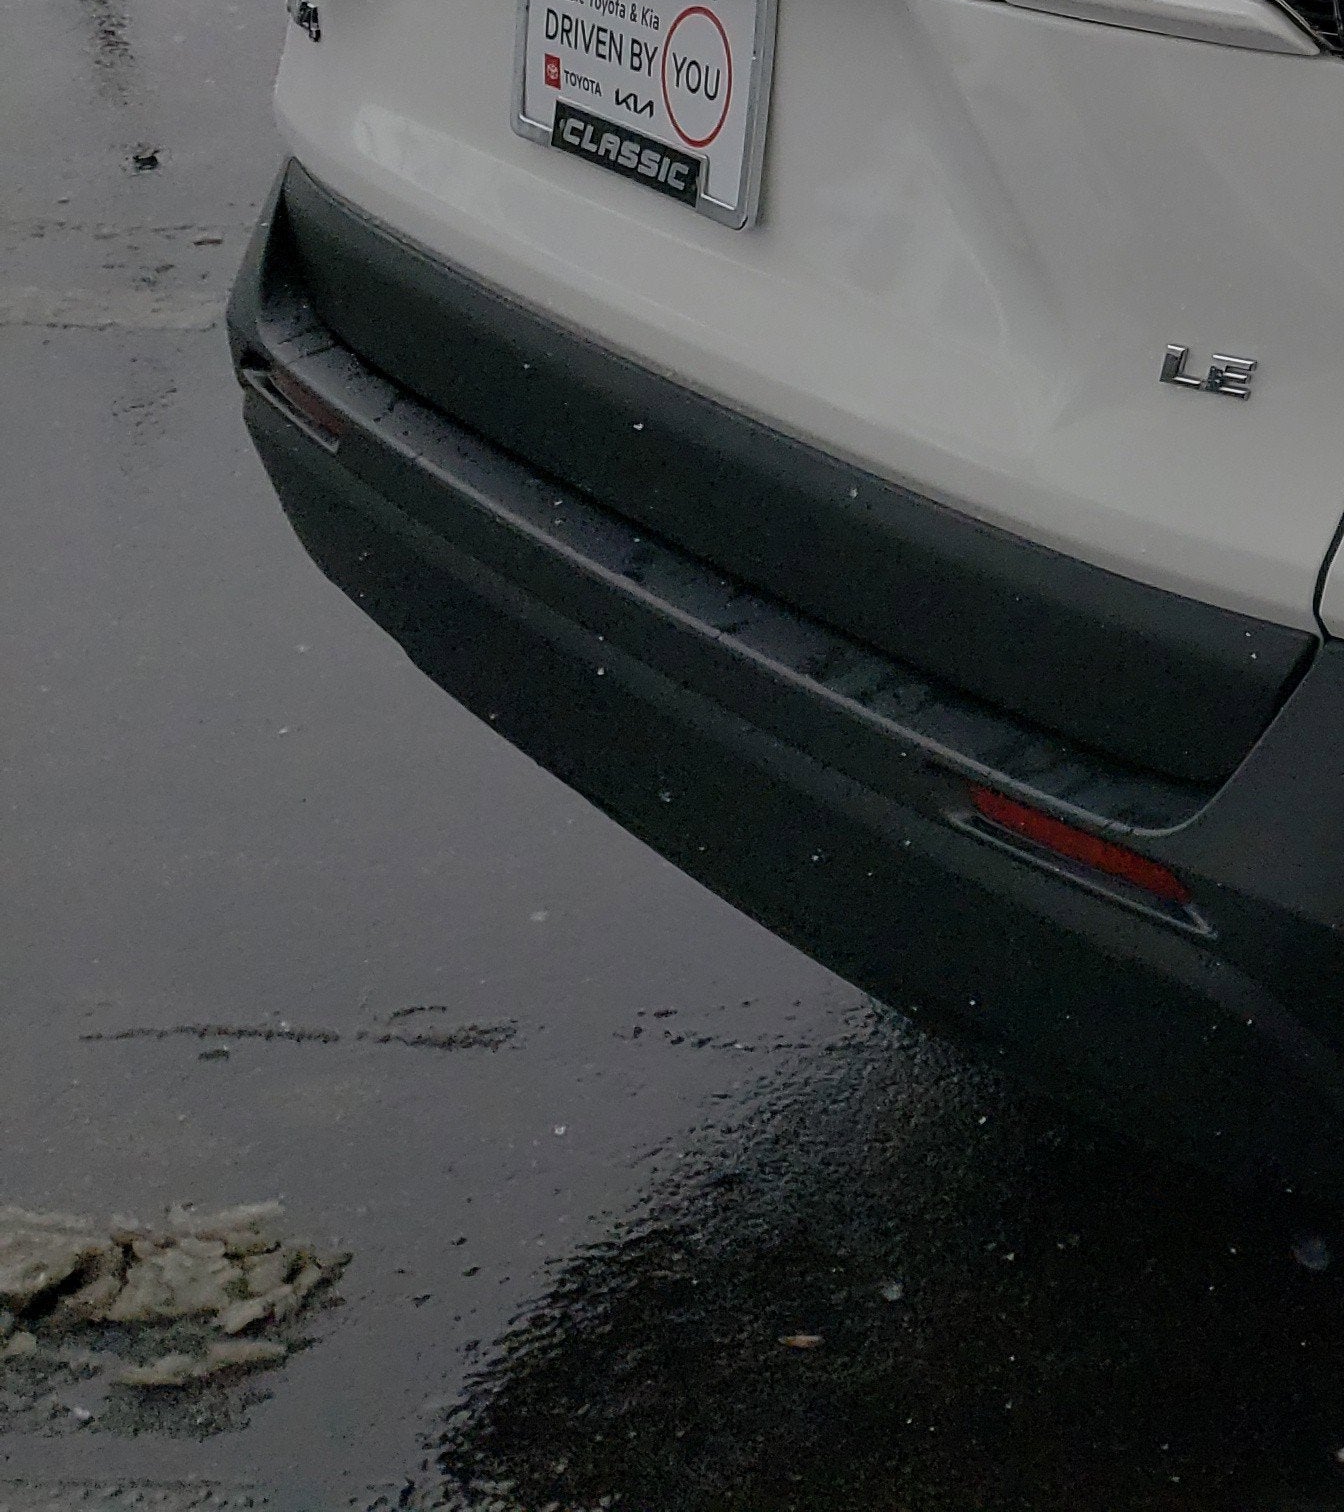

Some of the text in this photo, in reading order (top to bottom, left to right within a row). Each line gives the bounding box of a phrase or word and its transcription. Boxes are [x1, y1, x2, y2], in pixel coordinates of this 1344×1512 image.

[629, 3, 637, 23] &
[641, 6, 660, 30] Kia
[545, 7, 720, 100] DRIVEN BY YOU
[564, 69, 602, 97] TOYOTA
[562, 118, 689, 190] CLASSIC
[1160, 344, 1257, 401] LE
